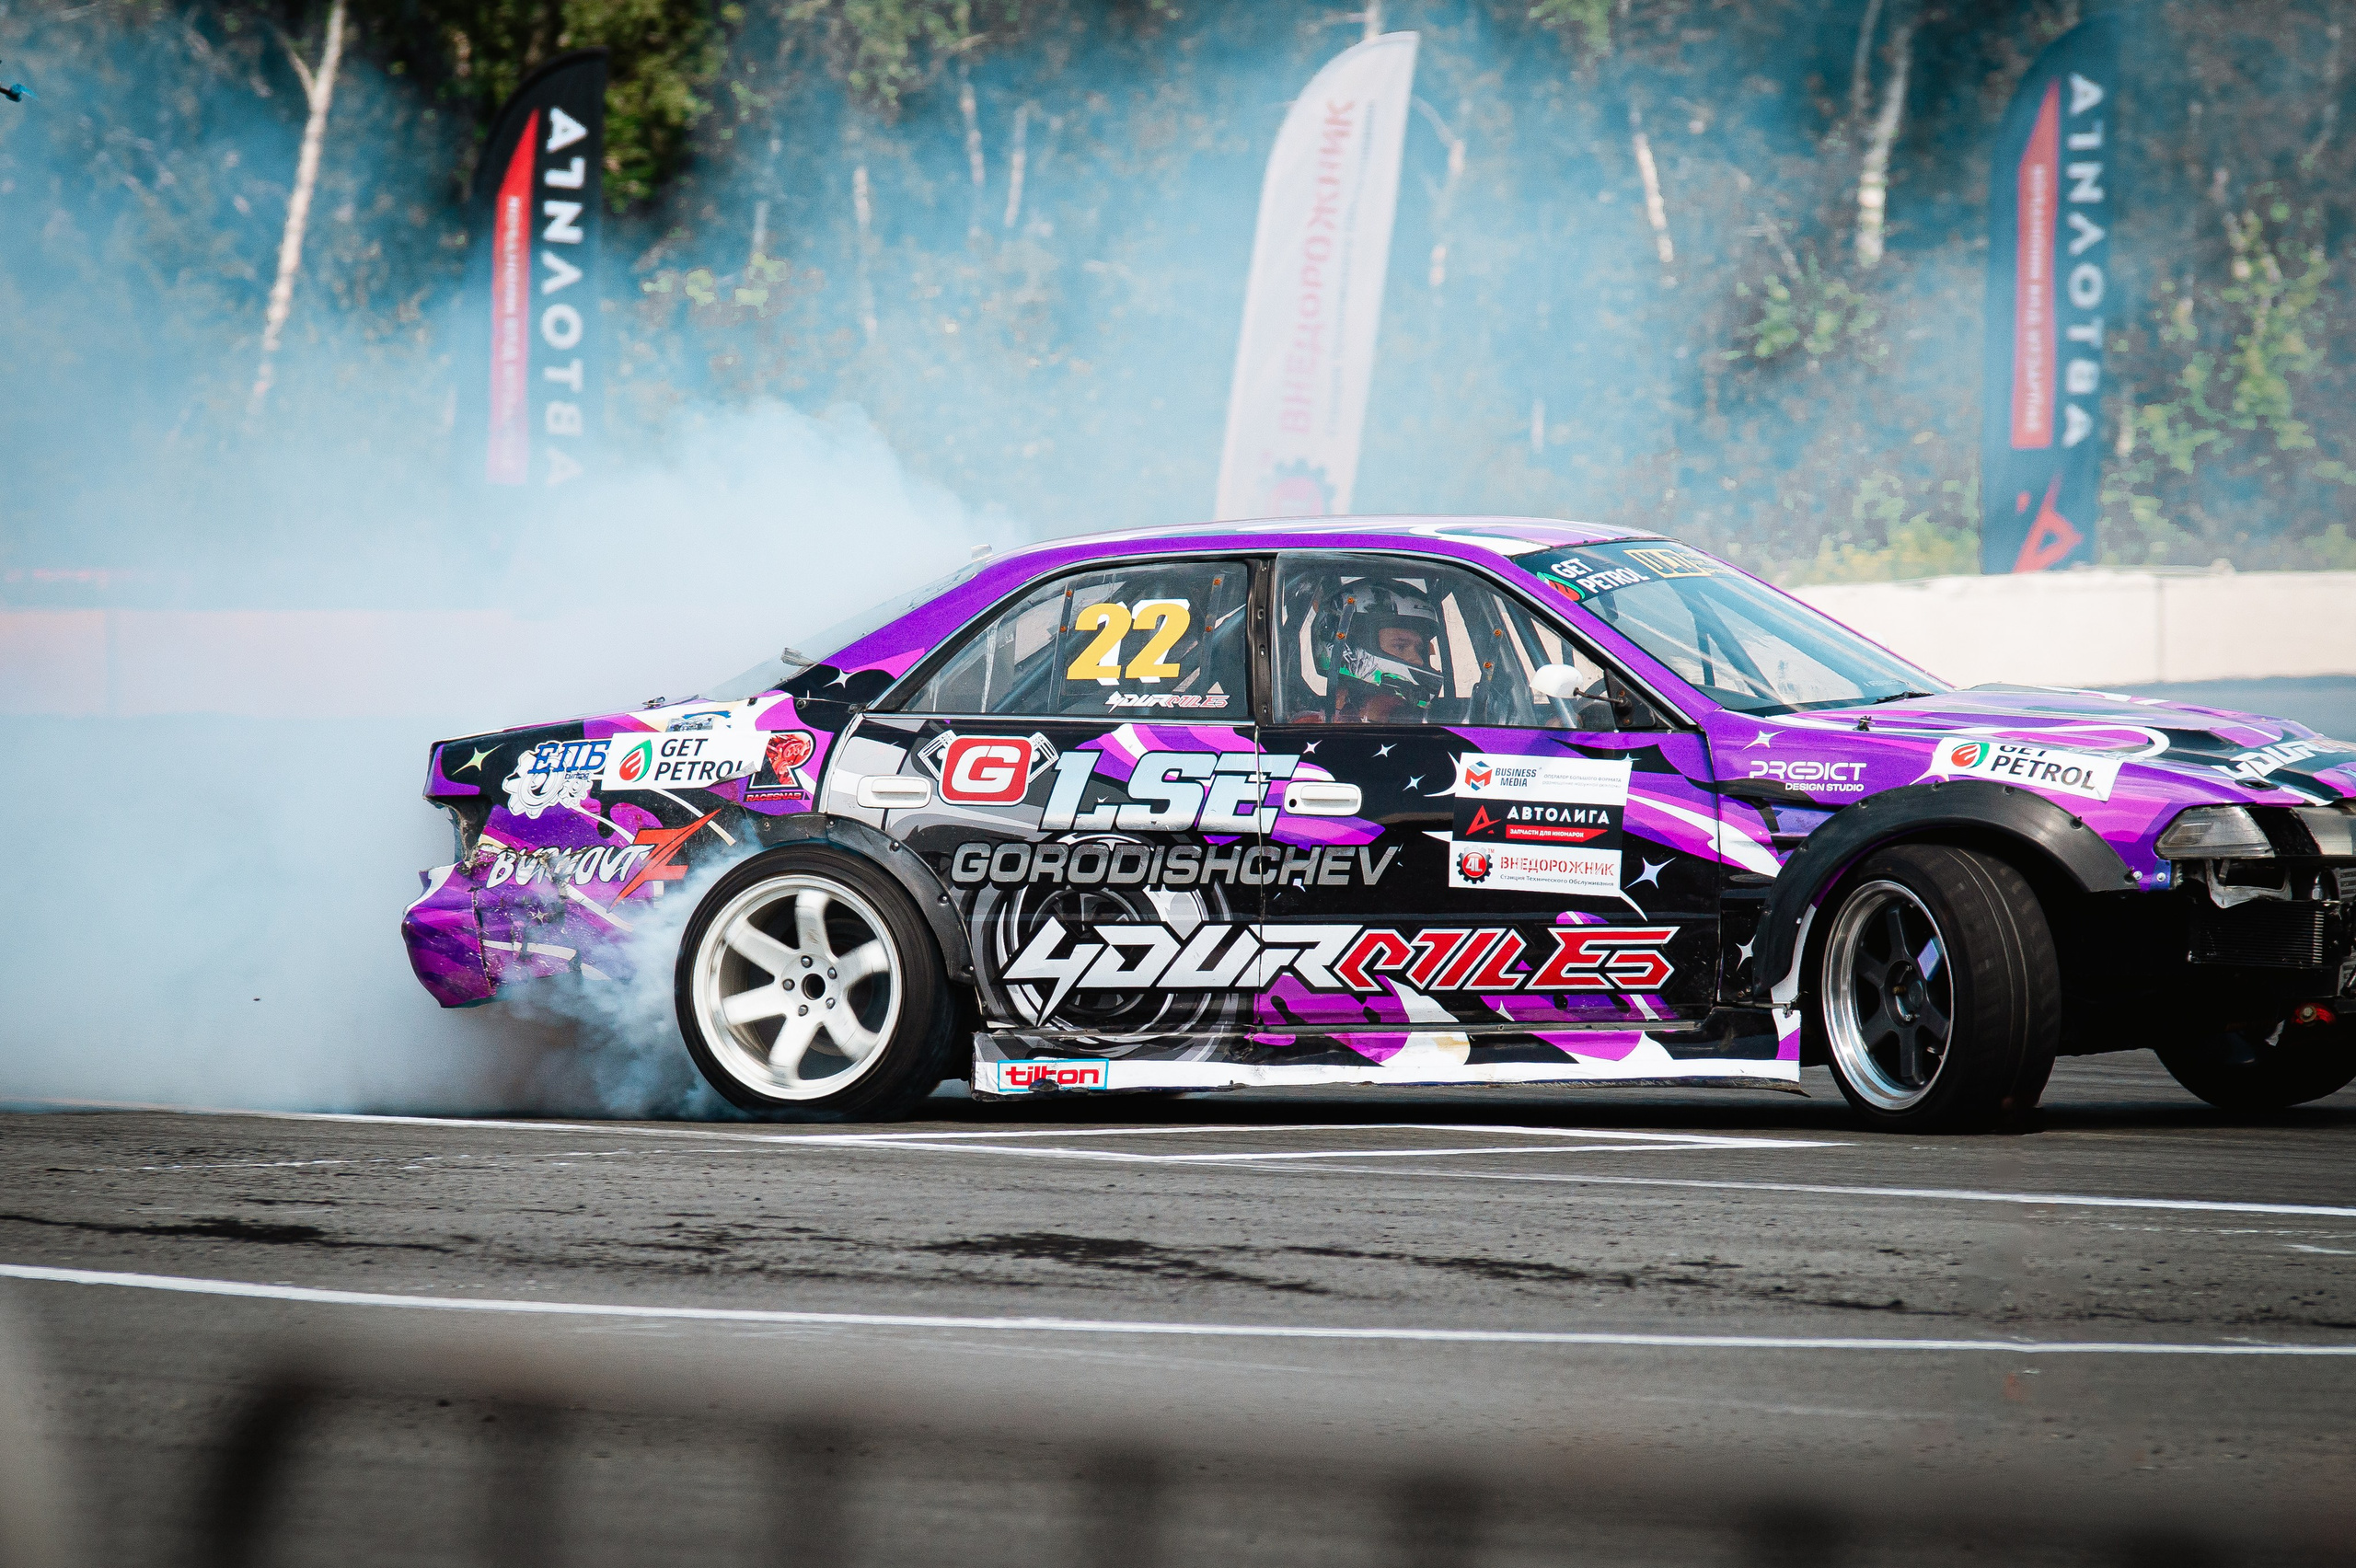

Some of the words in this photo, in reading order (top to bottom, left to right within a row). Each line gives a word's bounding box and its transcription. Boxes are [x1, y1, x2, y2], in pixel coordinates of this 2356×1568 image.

[1550, 558, 1594, 579] GET
[1576, 567, 1651, 594] PETROL
[1066, 601, 1191, 680] 22
[527, 740, 612, 774] ЕПБ
[661, 738, 709, 757] GET
[951, 745, 1022, 794] G
[1495, 767, 1537, 778] BUSINESS
[1750, 760, 1867, 781] PREDICT
[1991, 755, 2096, 790] PETROL
[1500, 777, 1528, 787] MEDIA
[1785, 783, 1825, 791] DESIGN
[1826, 784, 1865, 792] STUDIO
[746, 792, 802, 801] RACESNAB
[1507, 806, 1611, 824] АВТОЛИГА
[1552, 830, 1585, 838] ИНОМАРОК
[952, 842, 1400, 885] GORODISHCHEV
[1465, 857, 1483, 872] 4L
[1500, 856, 1615, 876] ВНЕДОРОЖНИК
[1500, 874, 1525, 882] Станция
[1526, 875, 1568, 884] Технического
[1568, 878, 1614, 887] Обслуживания
[1005, 1066, 1100, 1086] tilton
